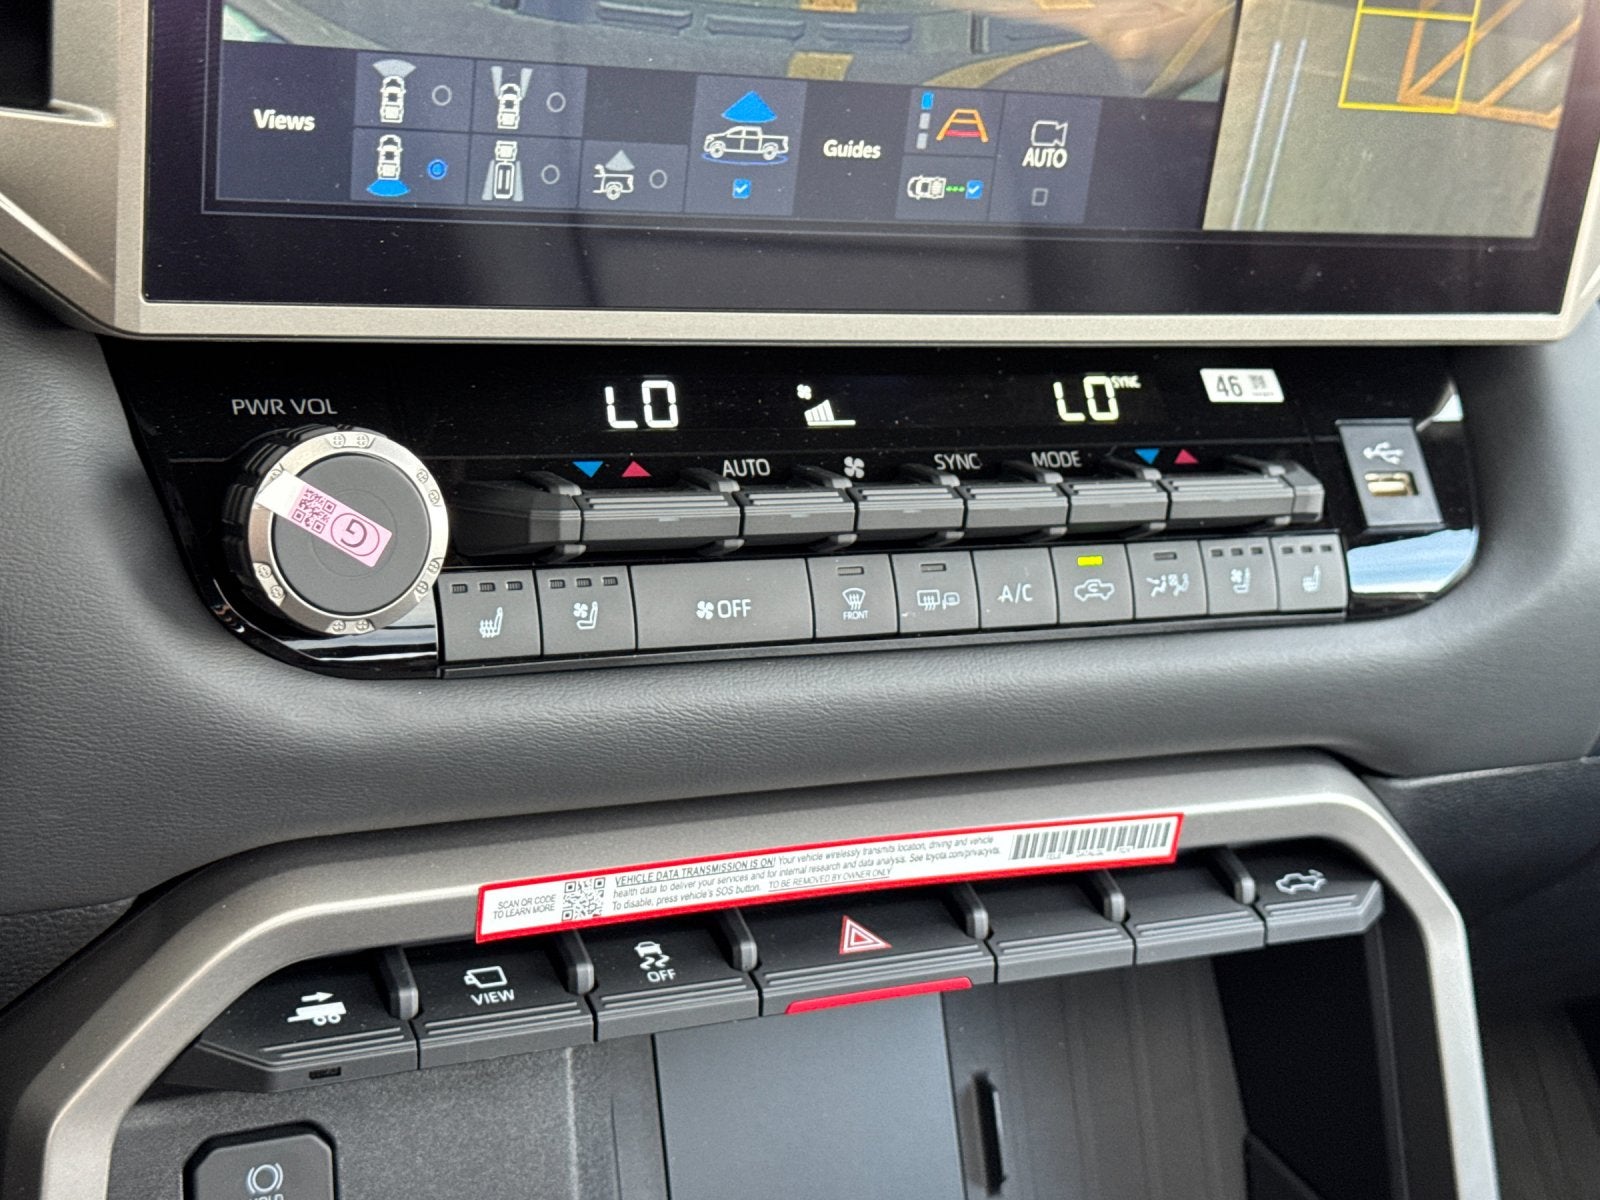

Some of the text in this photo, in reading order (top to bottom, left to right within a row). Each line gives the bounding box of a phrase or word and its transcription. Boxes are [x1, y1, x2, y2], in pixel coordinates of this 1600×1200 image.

[252, 108, 316, 132] Views
[823, 138, 881, 160] Guides
[1022, 147, 1068, 169] AUTO
[1110, 375, 1142, 389] SYNC
[1216, 375, 1243, 397] 46
[231, 398, 338, 416] PWR VOL
[604, 380, 679, 428] LO
[1053, 376, 1119, 421] LO
[722, 458, 771, 478] AUTO
[933, 452, 983, 471] SYNC
[1031, 450, 1083, 469] MODE
[999, 583, 1033, 603] A/C
[717, 599, 752, 619] OFF
[842, 610, 869, 621] FRONT
[615, 835, 994, 886] VEHICLE DATA TRANSMISSION IS ON! Your vehicle wirelessly transmits location, driving and vehicle
[613, 887, 638, 898] health
[640, 885, 657, 895] data
[659, 883, 668, 892] to
[670, 880, 696, 891] deliver
[698, 878, 715, 889] your
[717, 873, 748, 885] services
[750, 871, 765, 880] and
[767, 869, 778, 878] for
[779, 865, 807, 877] internal
[808, 862, 841, 873] research
[843, 859, 856, 869] and
[858, 858, 874, 867] data
[876, 855, 906, 867] analysis.
[909, 852, 923, 862] See
[769, 867, 892, 888] TO BE REMOVED BY OWNER ONLY
[498, 899, 519, 910] SCAN
[534, 894, 556, 905] CODE
[612, 901, 621, 911] To
[624, 897, 653, 908] disable,
[656, 895, 678, 906] press
[680, 889, 713, 900] vehicle's
[715, 886, 734, 896] SOS
[494, 903, 555, 920] TO LEARN MORE
[646, 967, 677, 984] OFF
[470, 988, 515, 1007] VIEW
